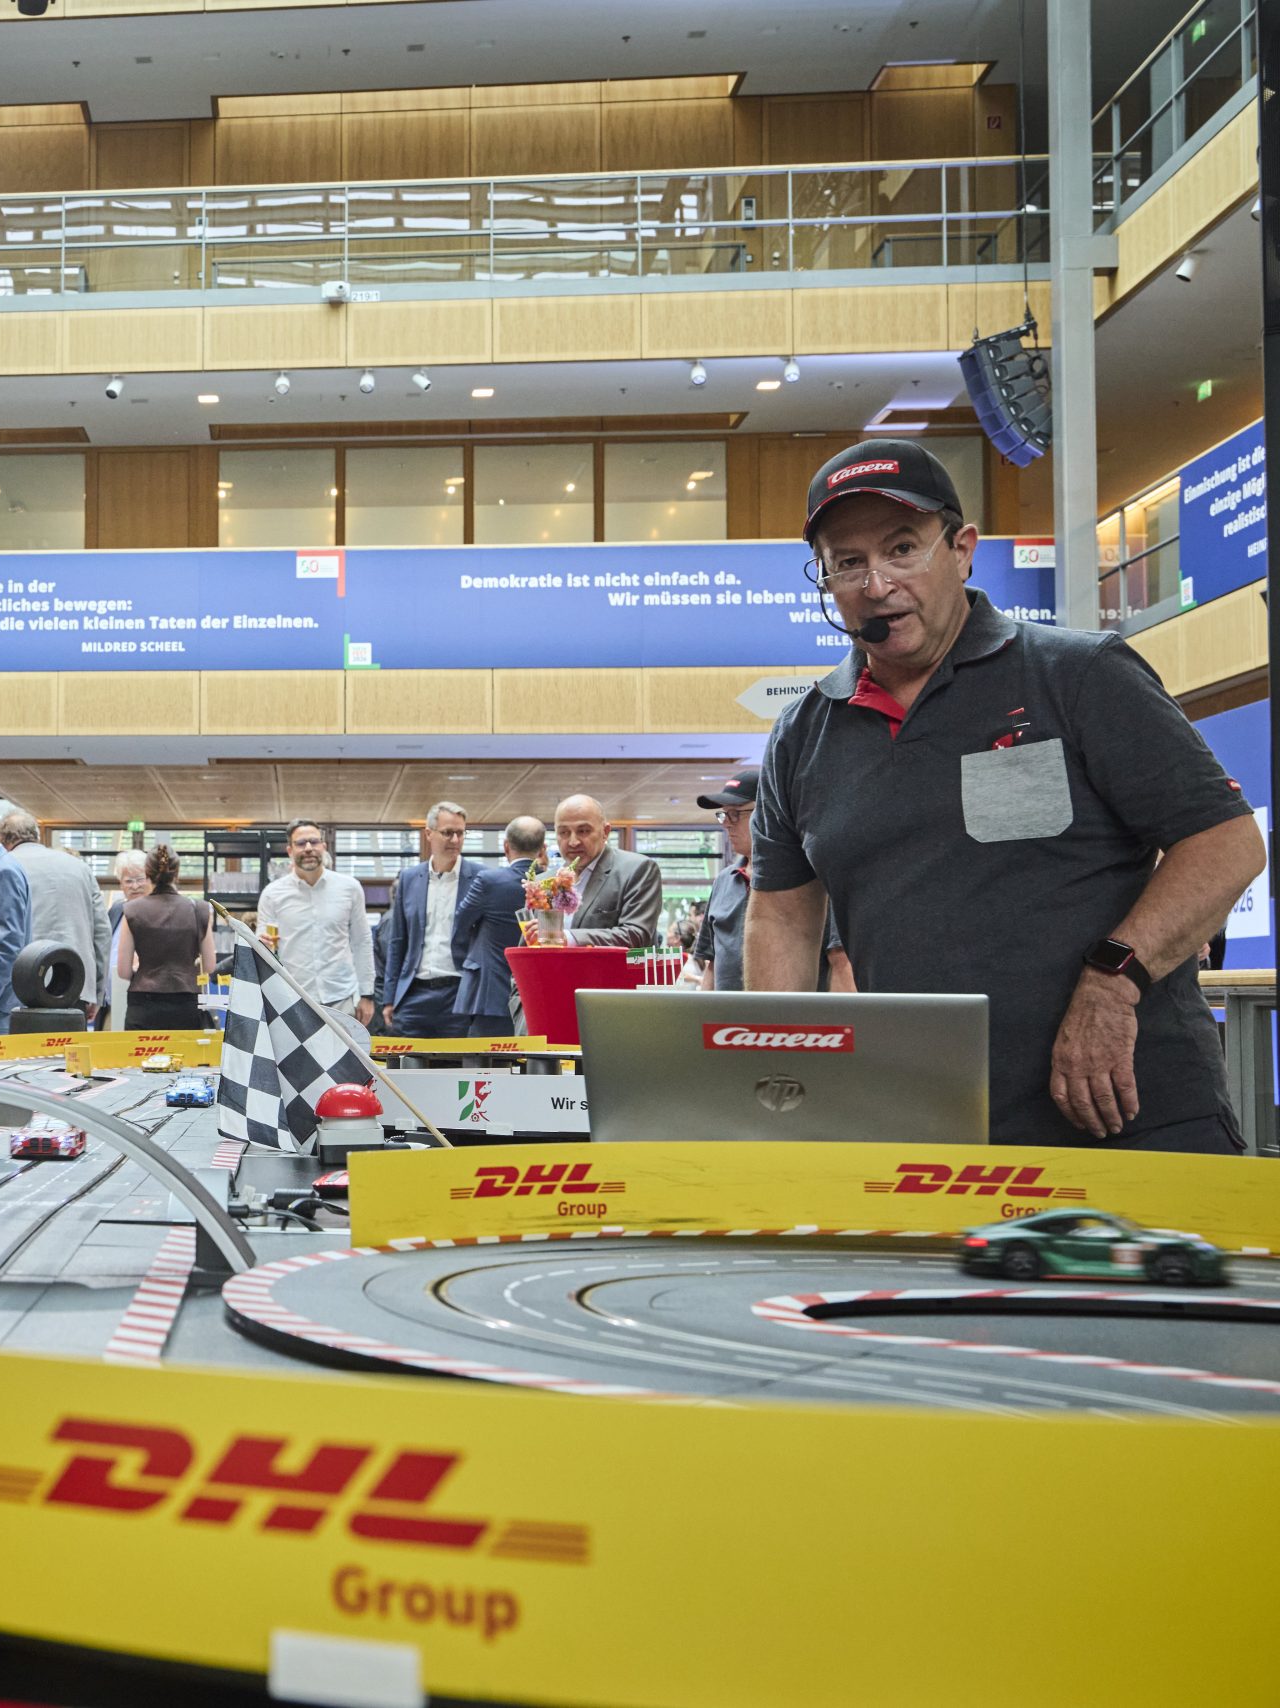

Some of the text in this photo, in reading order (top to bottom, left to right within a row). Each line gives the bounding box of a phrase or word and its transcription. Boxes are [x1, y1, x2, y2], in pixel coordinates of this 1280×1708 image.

[831, 462, 894, 484] Carrera
[1183, 463, 1238, 504] Einmischung
[1237, 454, 1252, 474] ist
[1209, 472, 1265, 517] einzige Mögl
[1224, 505, 1266, 537] realistisc
[7, 579, 24, 594] in
[27, 579, 56, 594] der
[460, 570, 742, 589] Demokratie ist nicht einfach da.
[53, 597, 133, 614] bewegen:
[608, 591, 640, 606] Wir
[643, 590, 712, 606] müssen
[716, 590, 742, 605] sie
[746, 589, 796, 604] leben
[0, 616, 25, 631] die
[28, 616, 80, 630] vielen
[83, 616, 145, 630] kleinen
[149, 616, 197, 630] Taten
[200, 615, 229, 629] der
[232, 614, 319, 629] Einzelnen.
[788, 605, 1056, 623] wiede eiten.
[81, 641, 186, 653] MILDRED SCHEEL
[816, 634, 851, 647] HELE
[46, 1038, 73, 1047] DHL
[711, 1026, 845, 1048] Carrera
[490, 1043, 519, 1052] DHL
[550, 1096, 576, 1110] Wir
[473, 1163, 601, 1198] DHL
[893, 1163, 1055, 1198] DHL
[557, 1201, 607, 1218] Group
[1000, 1203, 1050, 1219] Gro
[43, 1416, 492, 1552] DHL
[331, 1564, 522, 1642] Group
